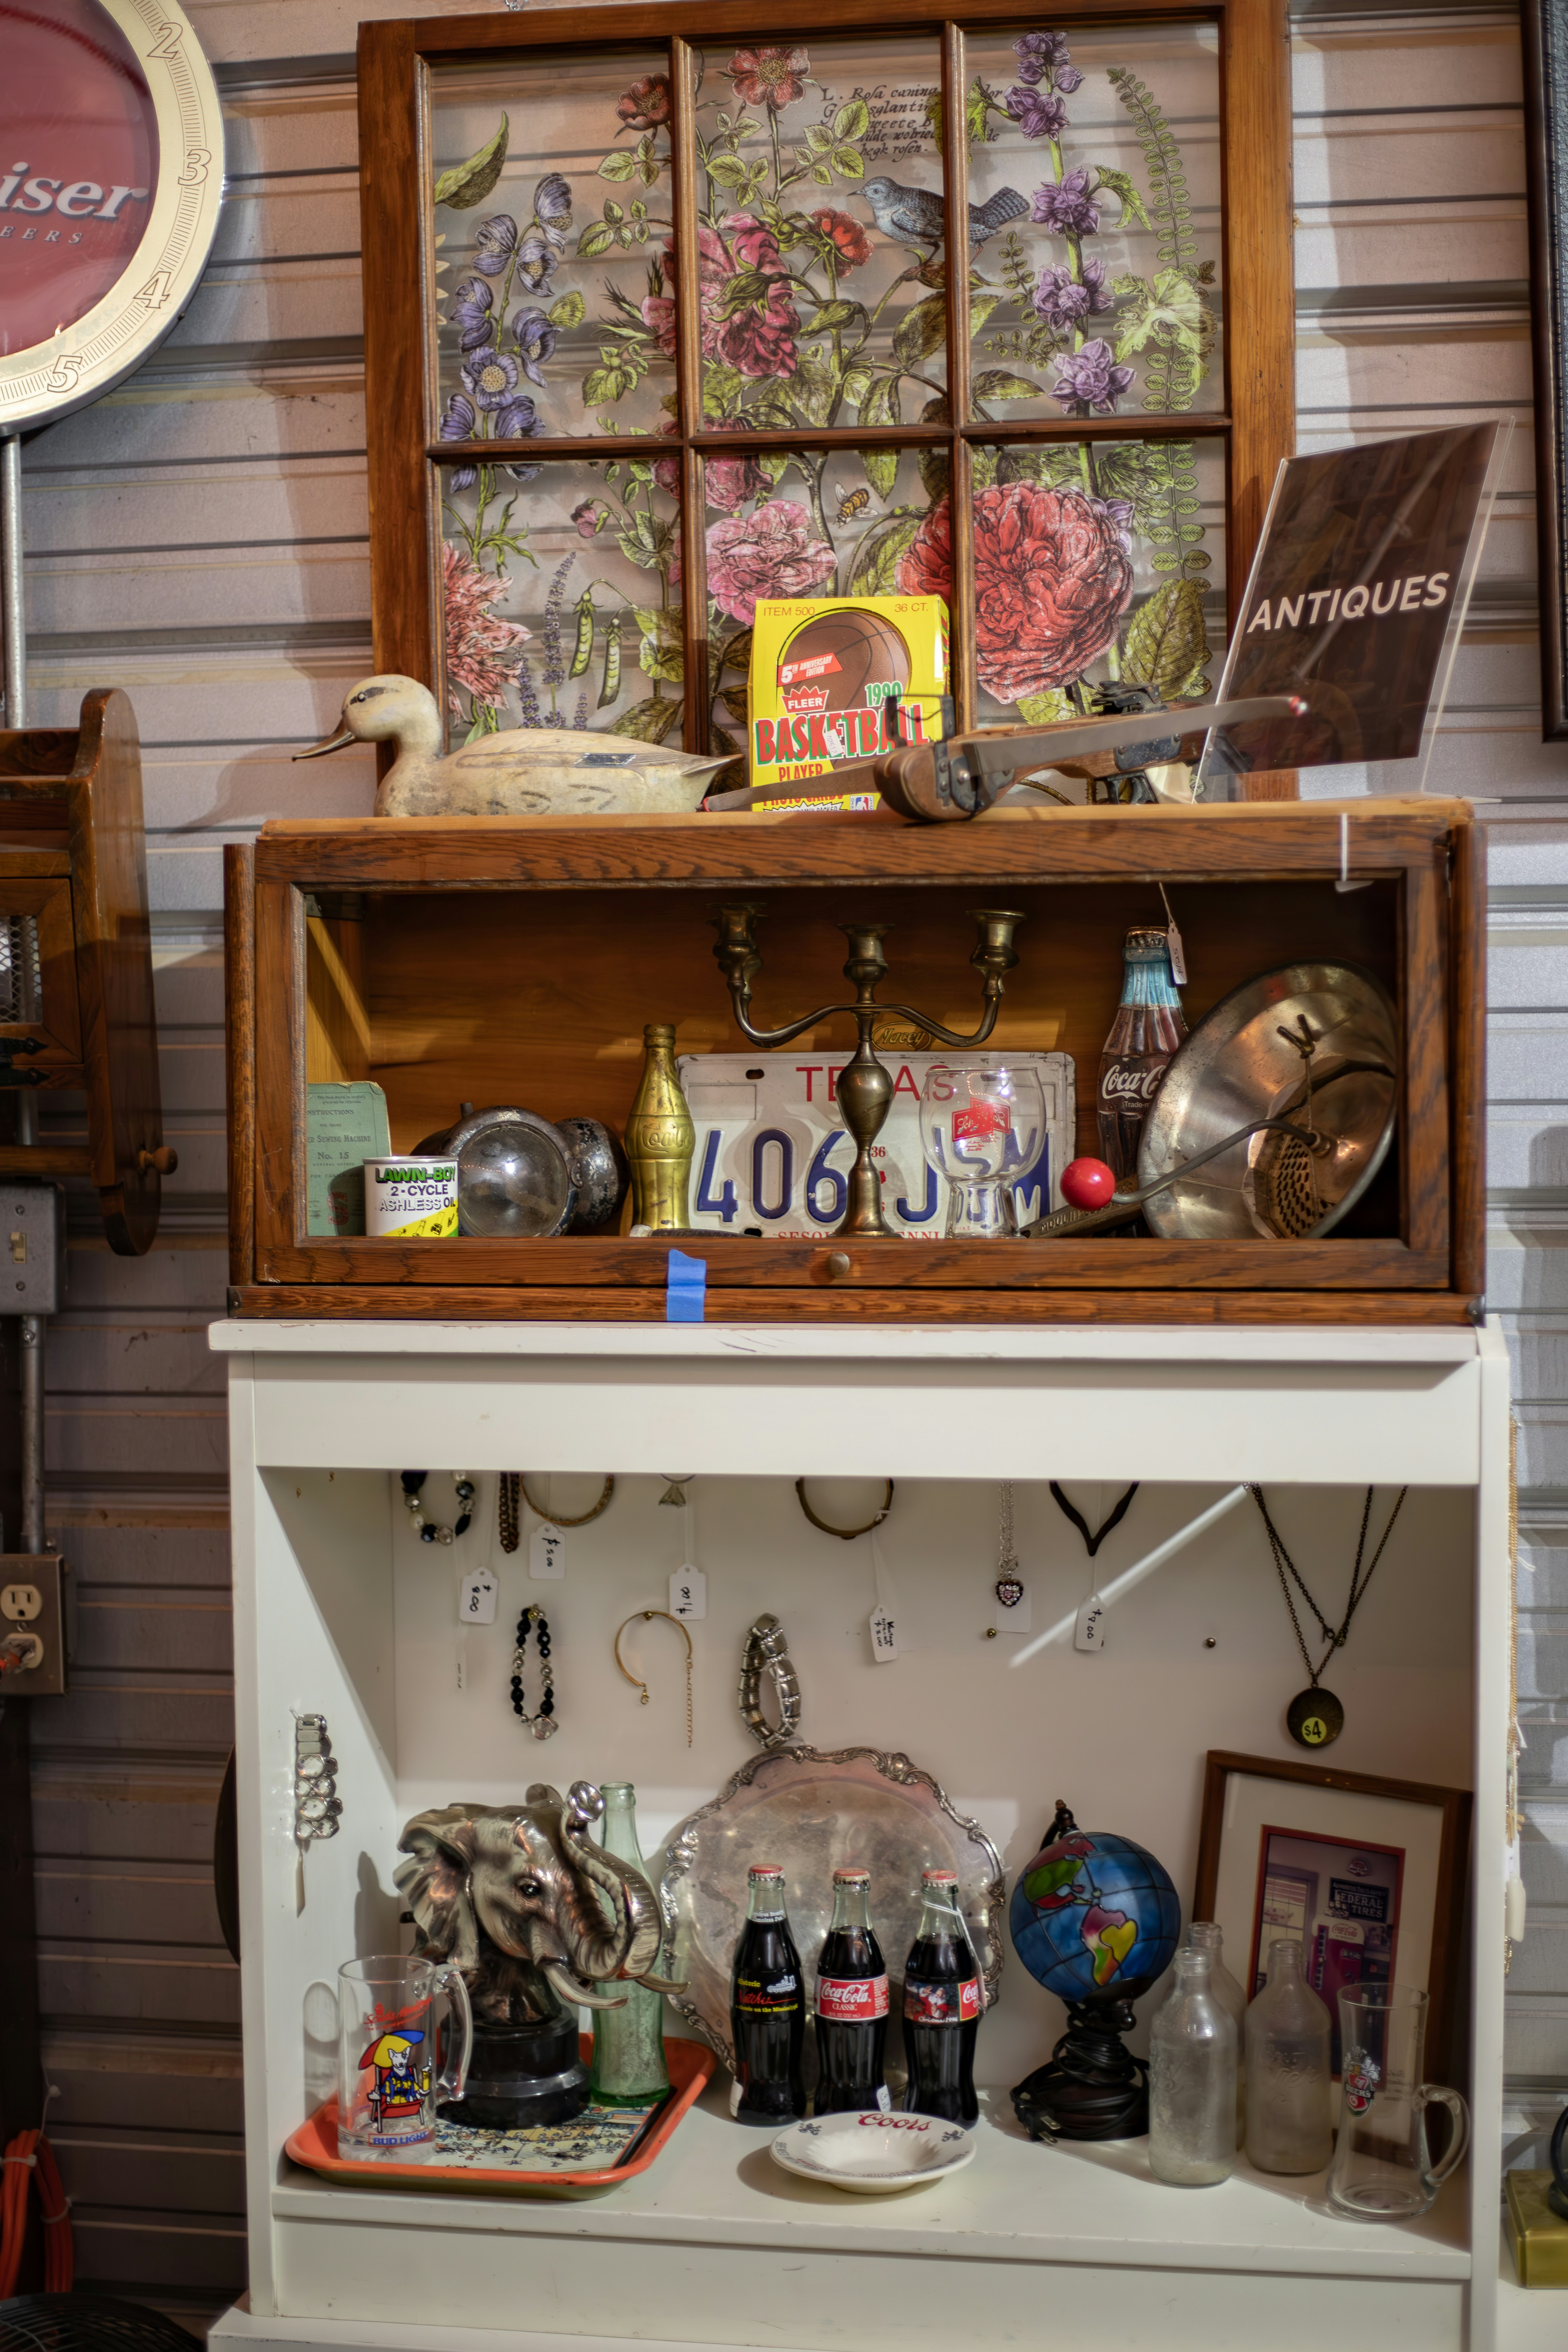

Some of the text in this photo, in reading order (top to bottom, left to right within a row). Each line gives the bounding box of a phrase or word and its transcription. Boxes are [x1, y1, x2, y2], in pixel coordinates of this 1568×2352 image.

[147, 22, 183, 59] 2
[178, 149, 212, 187] 3
[133, 271, 172, 309] 4
[47, 355, 83, 393] 5
[764, 603, 928, 616] ITEM 500 36 CT.
[1246, 572, 1450, 634] ANTIQUES
[799, 655, 833, 671] ANNIVERSARY
[806, 665, 825, 677] EDITION
[788, 697, 823, 709] FLEER
[865, 681, 903, 707] 1990
[755, 704, 929, 766] BASKETBALL
[875, 1028, 926, 1047] Macey
[796, 1064, 954, 1102] TEAS
[375, 1166, 456, 1184] LAWN-BOY
[696, 1129, 847, 1223] 406
[379, 1197, 456, 1211] ASHLESS OIL
[1334, 1890, 1383, 1909] FEDERAL
[1351, 1905, 1383, 1918] TIRES
[821, 1982, 869, 2003] Coca-Cola
[858, 2113, 933, 2131] Coors
[399, 2131, 428, 2144] LIGHT
